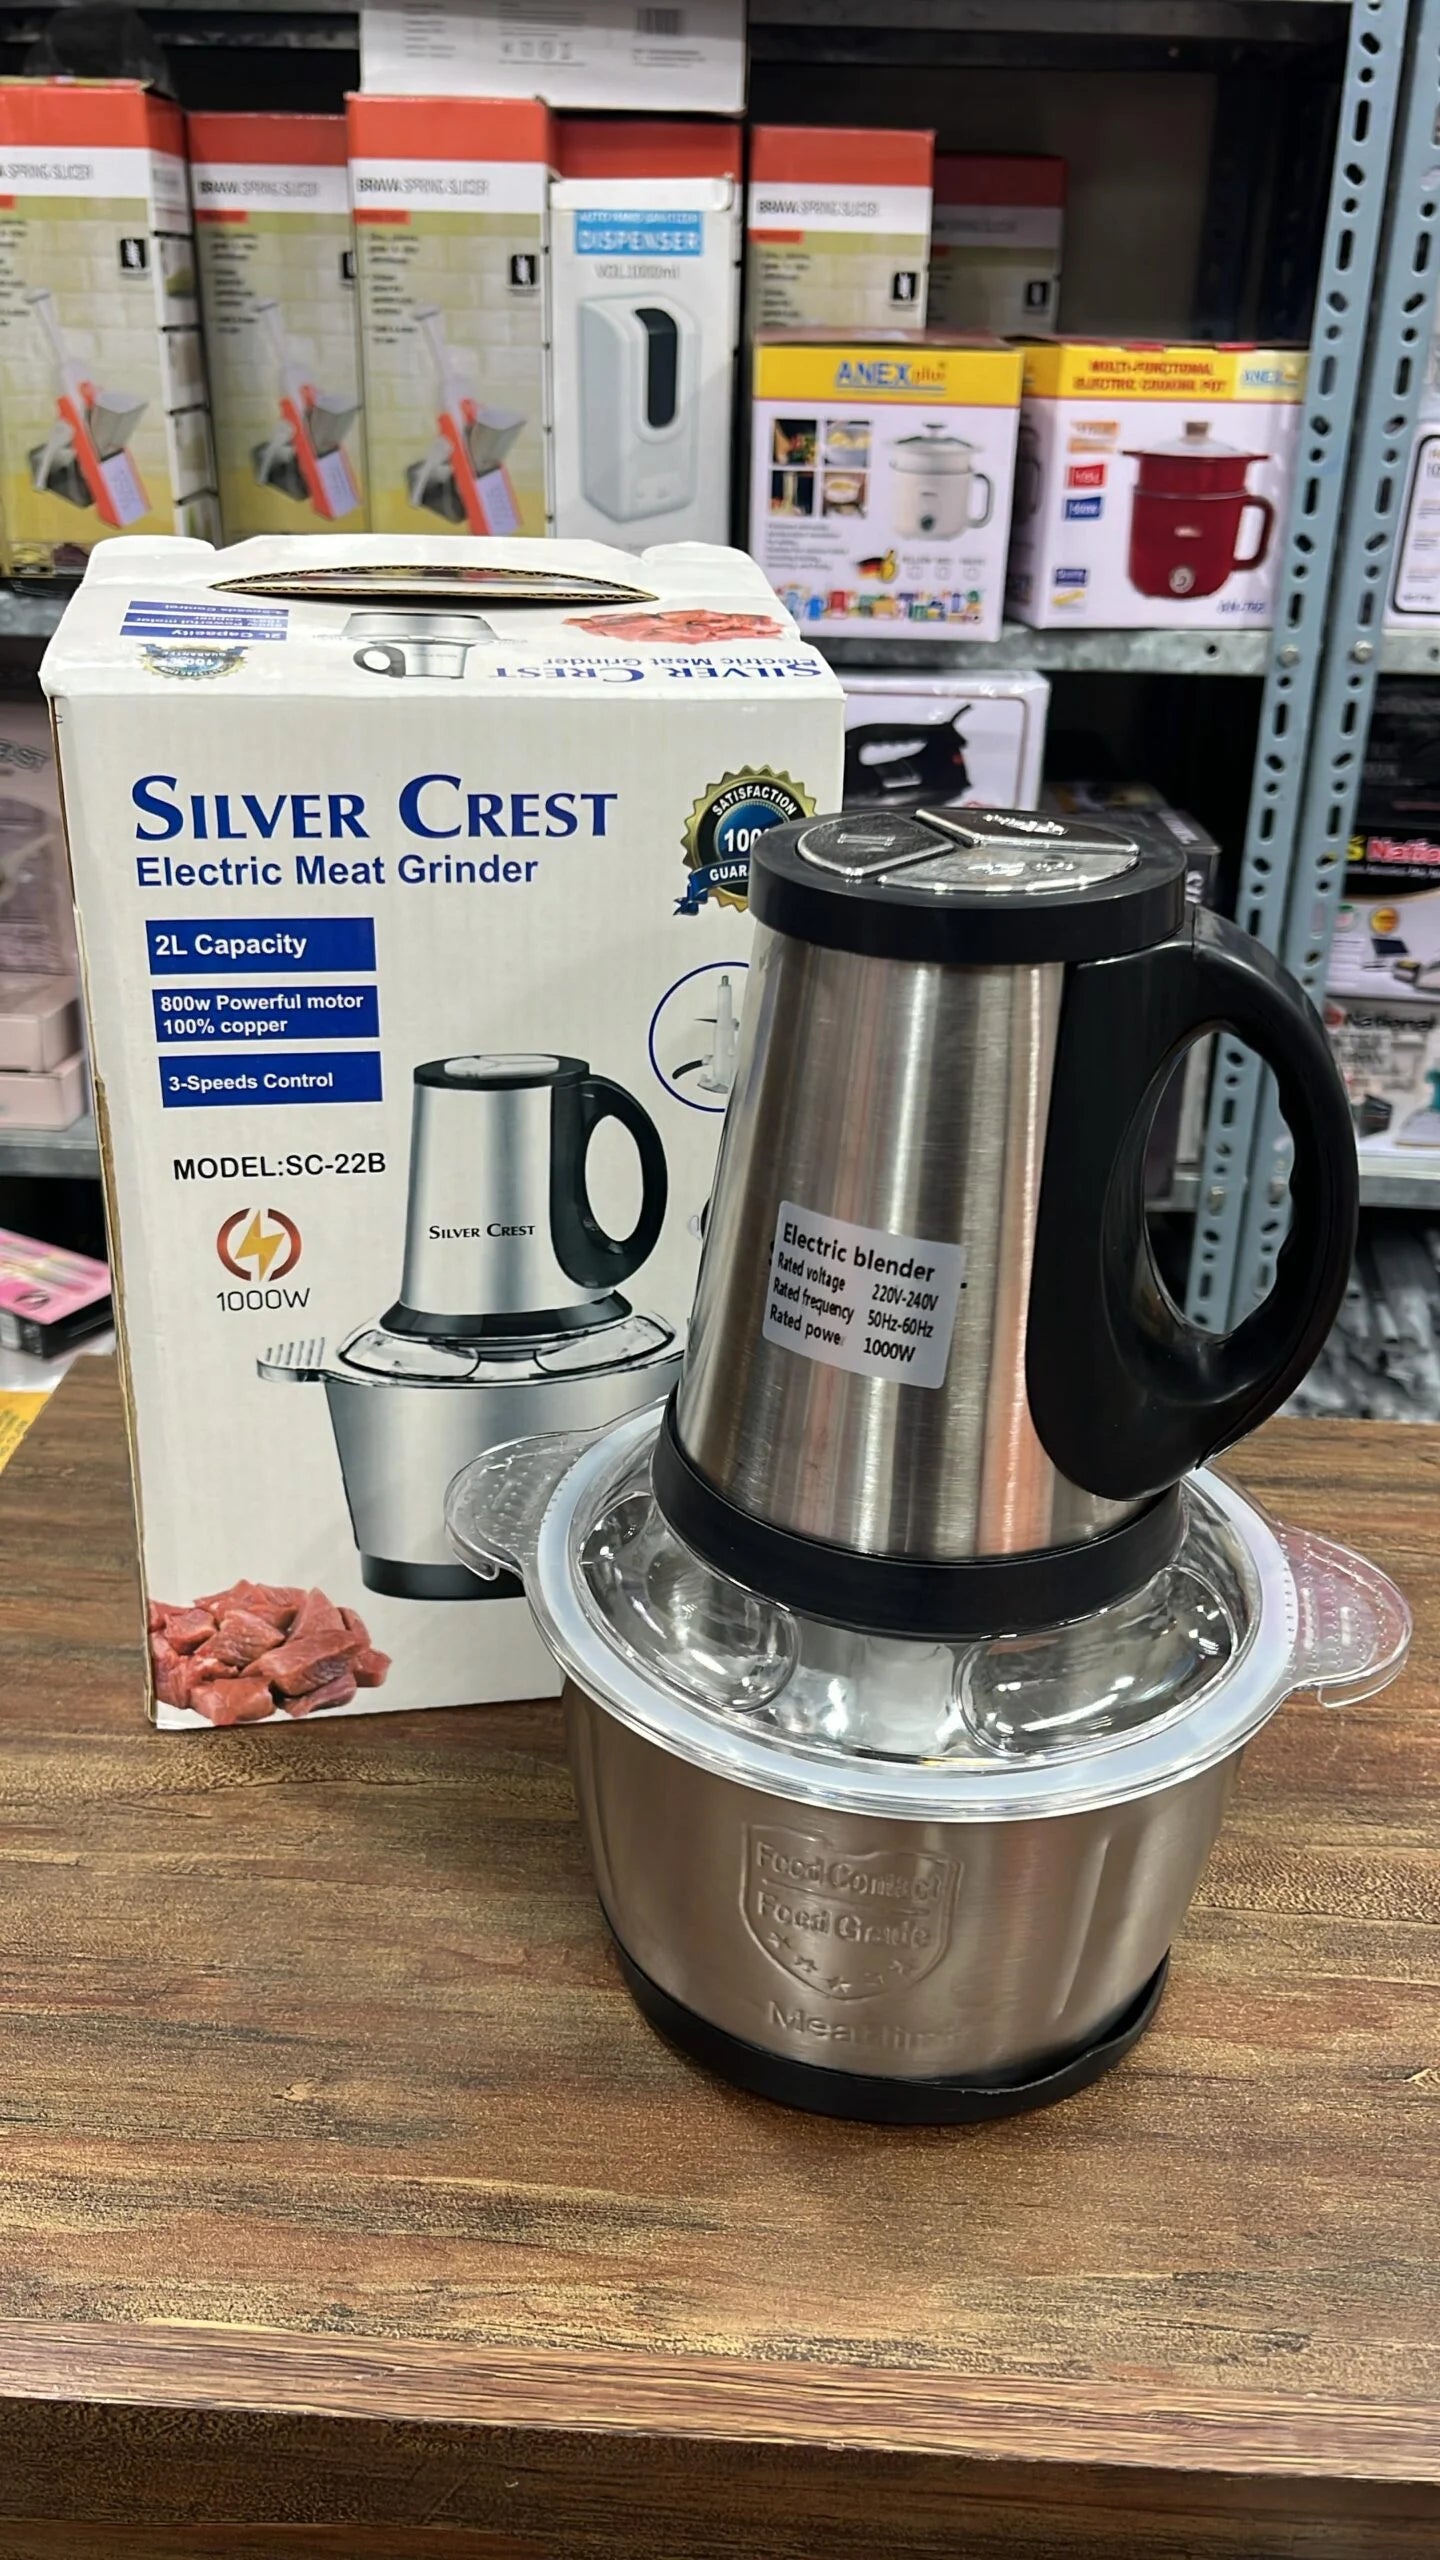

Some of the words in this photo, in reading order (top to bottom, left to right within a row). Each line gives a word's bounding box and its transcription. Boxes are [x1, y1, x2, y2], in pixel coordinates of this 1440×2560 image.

[578, 230, 699, 251] DISPENSER
[834, 361, 912, 387] ANEX
[171, 629, 253, 639] Capacity
[543, 657, 642, 667] Grinder
[650, 657, 712, 666] Meat
[668, 664, 821, 679] SILVER
[721, 658, 817, 668] Electric
[492, 668, 645, 684] CREST
[131, 774, 371, 842] SILVER
[399, 773, 618, 838] CREST
[711, 785, 798, 816] SATISFACTION
[135, 855, 283, 887] Electric
[295, 855, 386, 886] Meat
[397, 854, 540, 885] Grinder
[154, 935, 188, 956] 2L
[194, 933, 308, 960] Capacity
[160, 995, 211, 1012] 800w
[216, 994, 302, 1012] Powerful
[307, 994, 364, 1010] motor
[163, 1018, 215, 1036] 100%
[220, 1016, 288, 1037] copper
[168, 1073, 261, 1092] 3-Speeds
[264, 1071, 334, 1089] Control
[173, 1152, 387, 1181] MODEL:SC-22B
[429, 1225, 480, 1240] SILVER
[486, 1222, 536, 1238] CREST
[783, 1221, 848, 1264] Electric
[853, 1245, 936, 1283] blender
[777, 1251, 804, 1278] Rated
[806, 1265, 846, 1295] voltage
[871, 1282, 940, 1313] 220V-240V
[217, 1287, 311, 1312] 1000W
[773, 1276, 800, 1303] Rated
[802, 1287, 855, 1326] frequency
[867, 1308, 935, 1339] 50Hz-60Hz
[769, 1303, 802, 1332] Rated
[804, 1321, 846, 1347] power
[862, 1336, 917, 1363] 1000W
[756, 1841, 827, 1885] Food
[757, 1890, 832, 1935] Food
[838, 1915, 931, 1950] Grade
